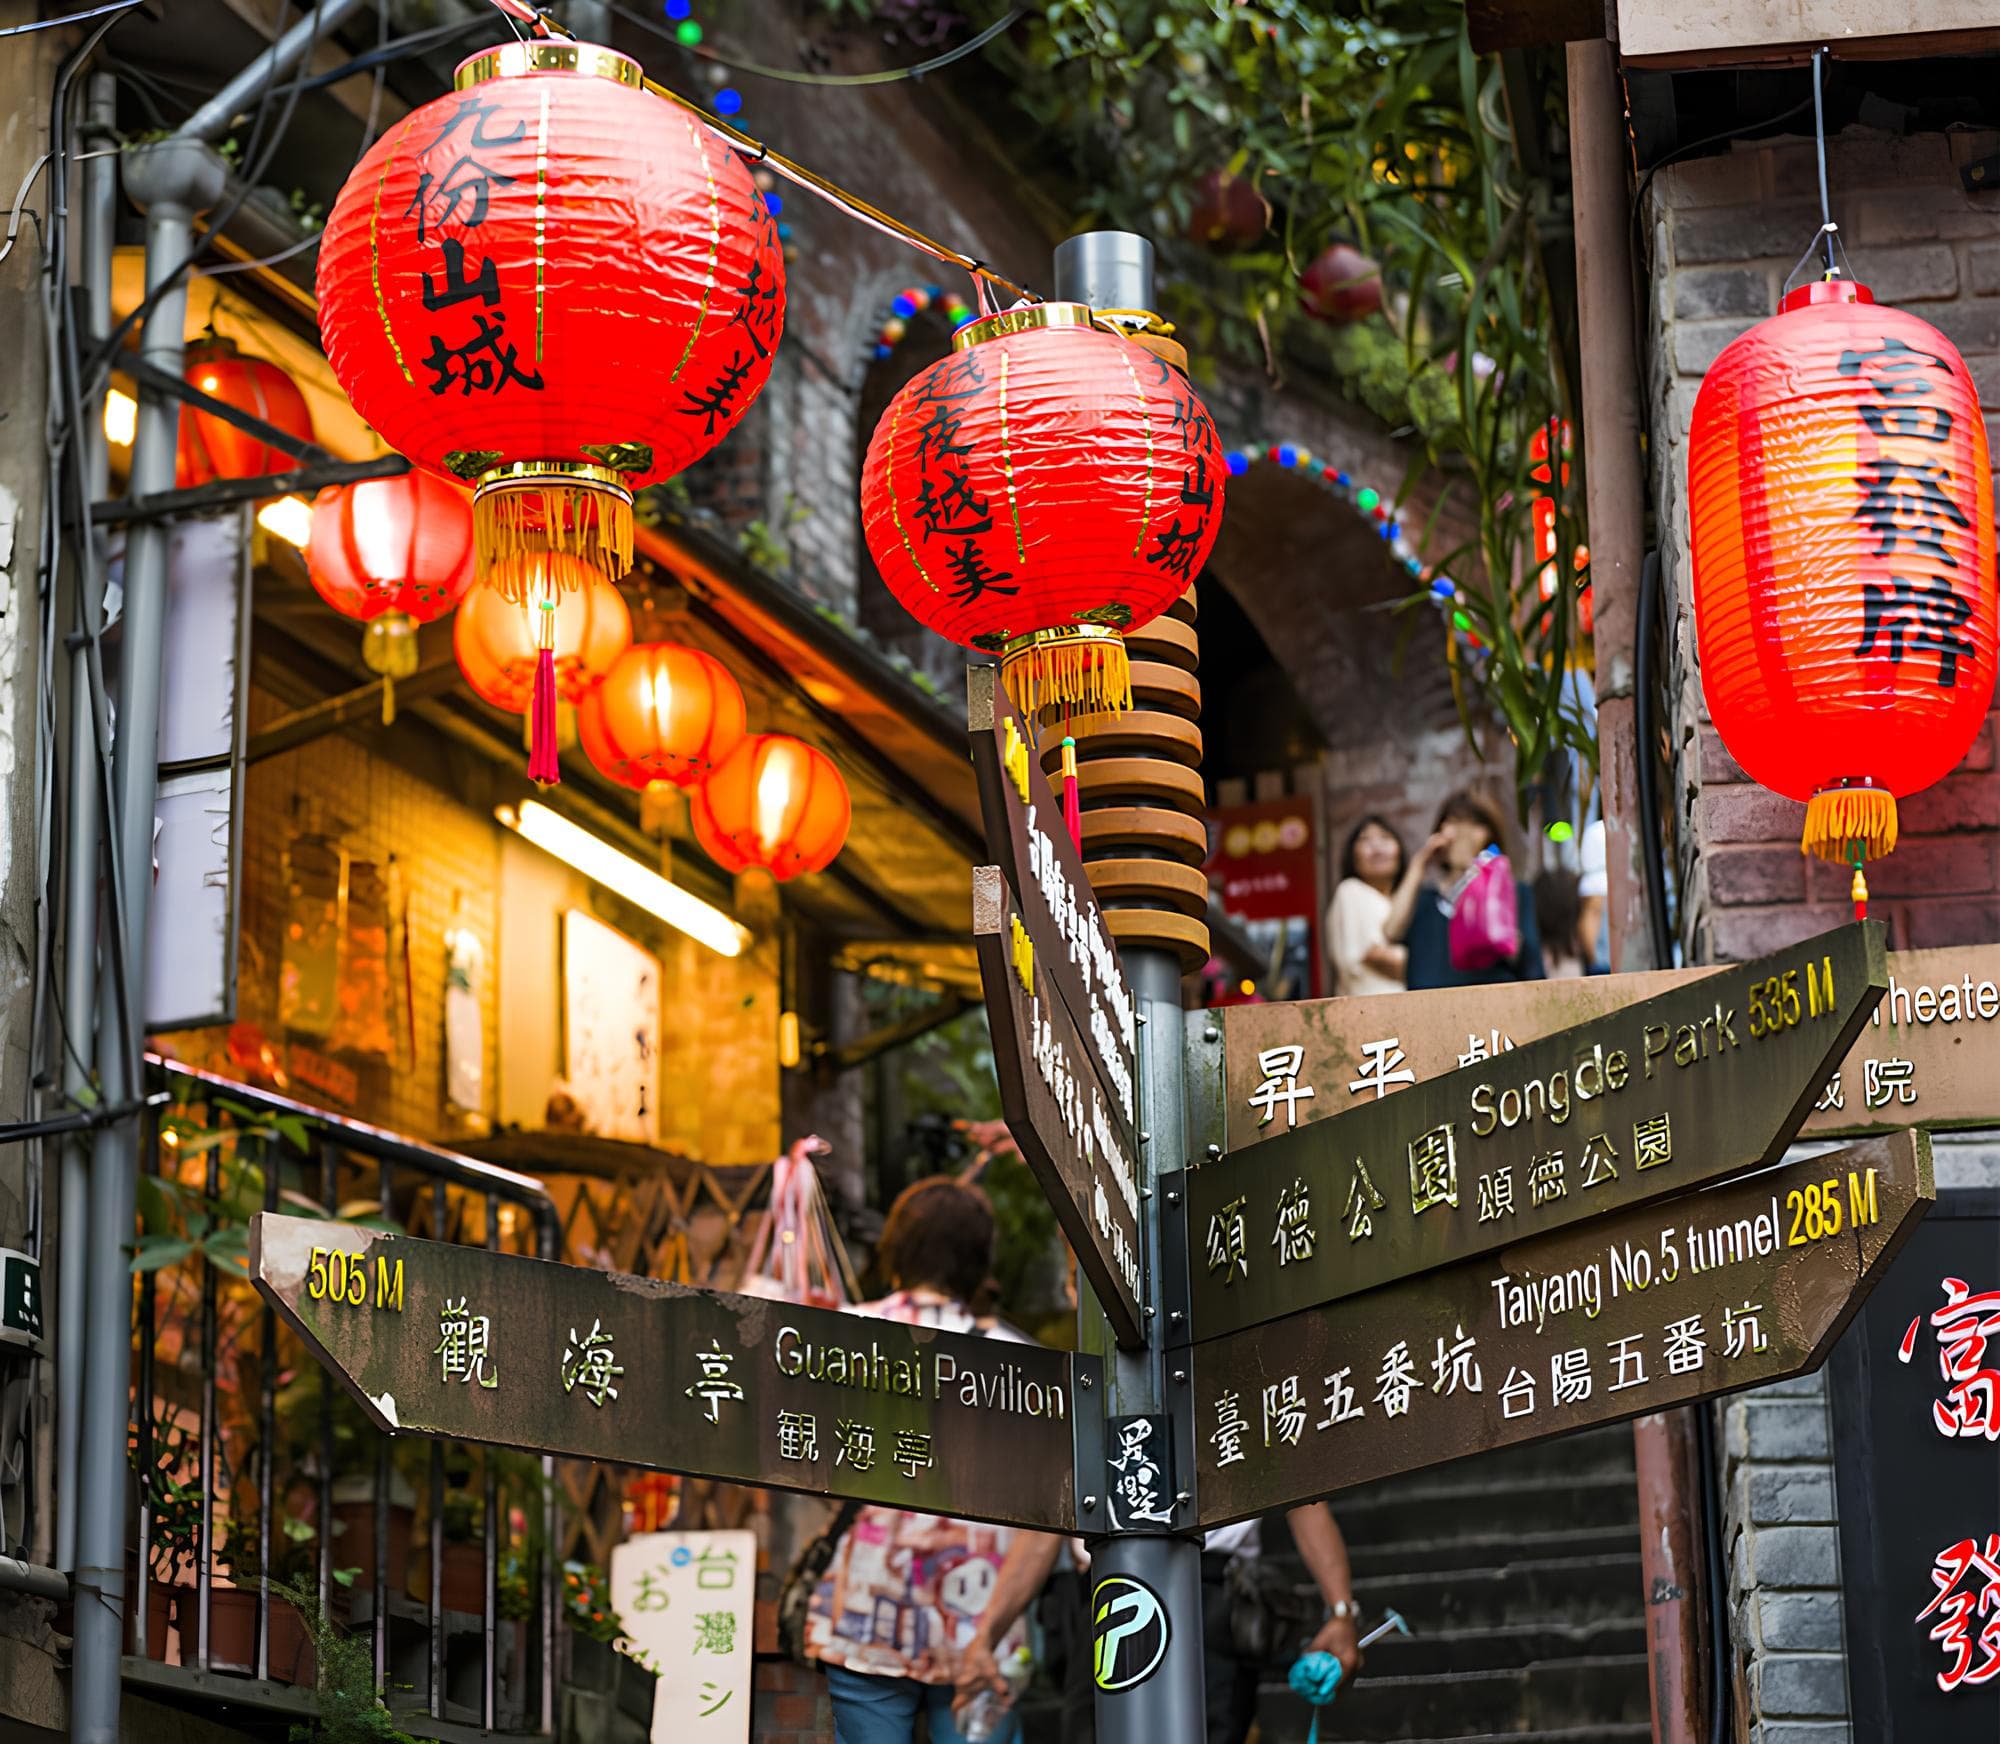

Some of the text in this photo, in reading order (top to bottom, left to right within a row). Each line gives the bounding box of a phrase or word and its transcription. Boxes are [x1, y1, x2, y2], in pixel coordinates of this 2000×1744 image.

[404, 98, 544, 396] 九份山城
[908, 350, 1020, 608] 越夜越美
[1471, 956, 1836, 1136] Songde Park 535 M
[1872, 973, 2000, 1025] heate
[309, 1247, 403, 1312] 505 M
[1491, 1168, 1878, 1334] Taiyang No.5 tunnel 285 M
[434, 1296, 743, 1425] 觀海亭
[775, 1326, 1064, 1419] Guanhai Pavilion
[1210, 1324, 1482, 1467] 臺陽五番坑
[1498, 1301, 1767, 1419] 台陽五番坑
